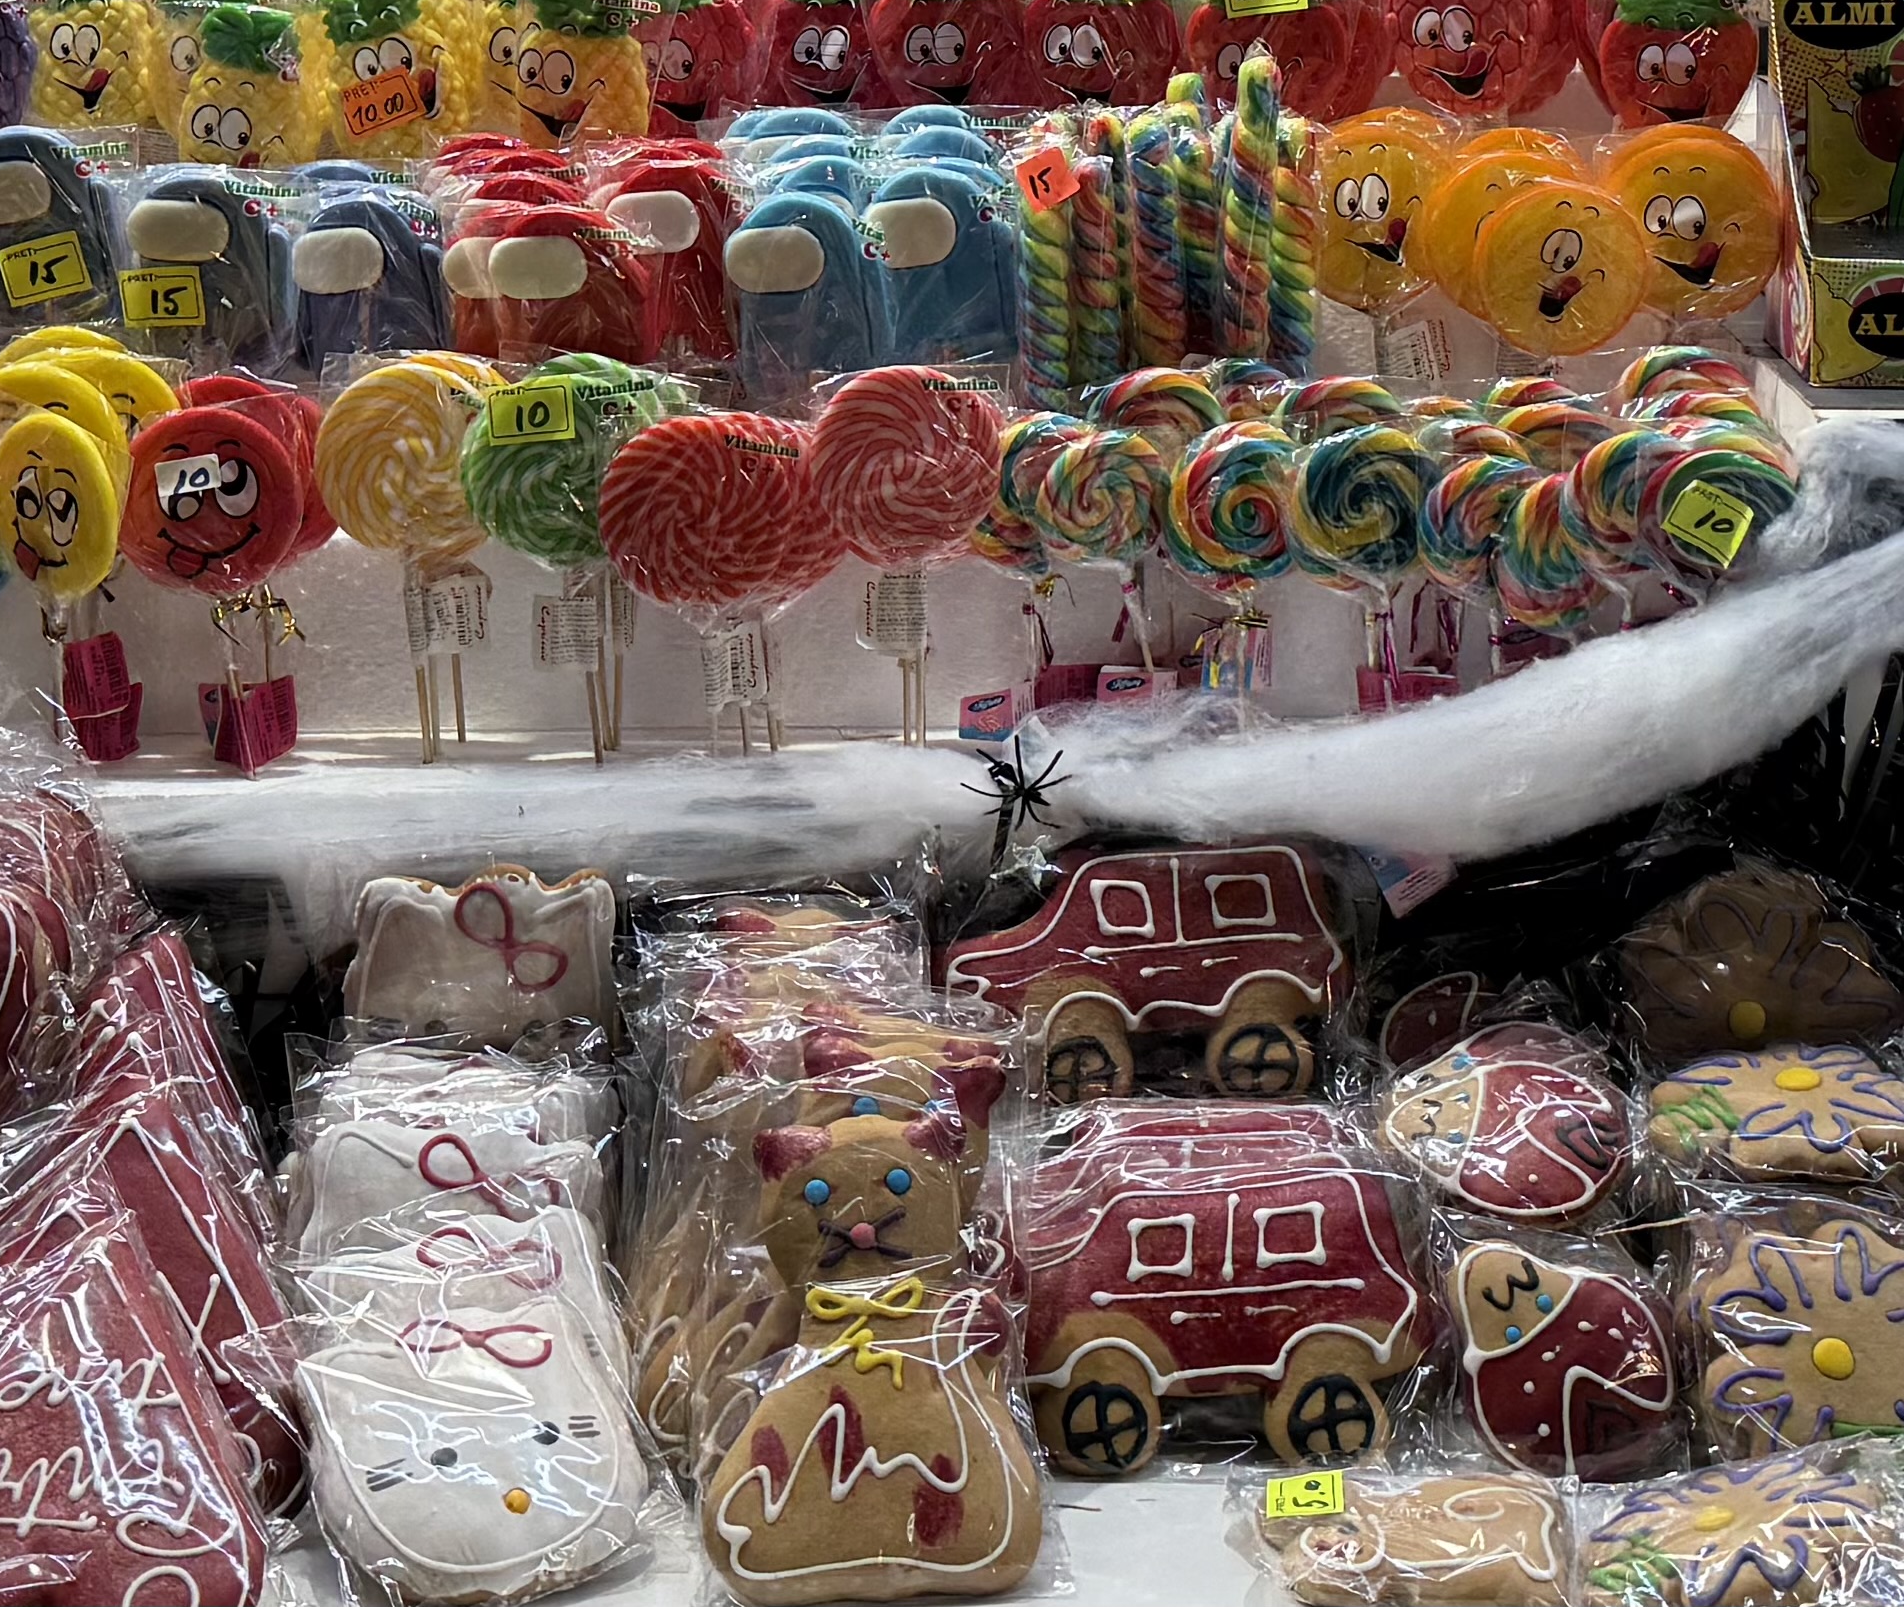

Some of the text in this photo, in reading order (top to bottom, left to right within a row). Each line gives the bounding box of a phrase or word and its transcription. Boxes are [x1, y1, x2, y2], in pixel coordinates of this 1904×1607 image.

[352, 93, 404, 128] 10.00
[53, 143, 128, 157] Vitamina
[224, 181, 300, 197] Vitamina
[1029, 167, 1051, 199] 15
[29, 255, 68, 285] 15
[151, 287, 188, 314] 15
[577, 379, 653, 400] Vitamina
[922, 378, 998, 390] Vitamina
[516, 401, 550, 431] 10
[725, 437, 800, 458] Vitamina
[177, 467, 210, 494] 10
